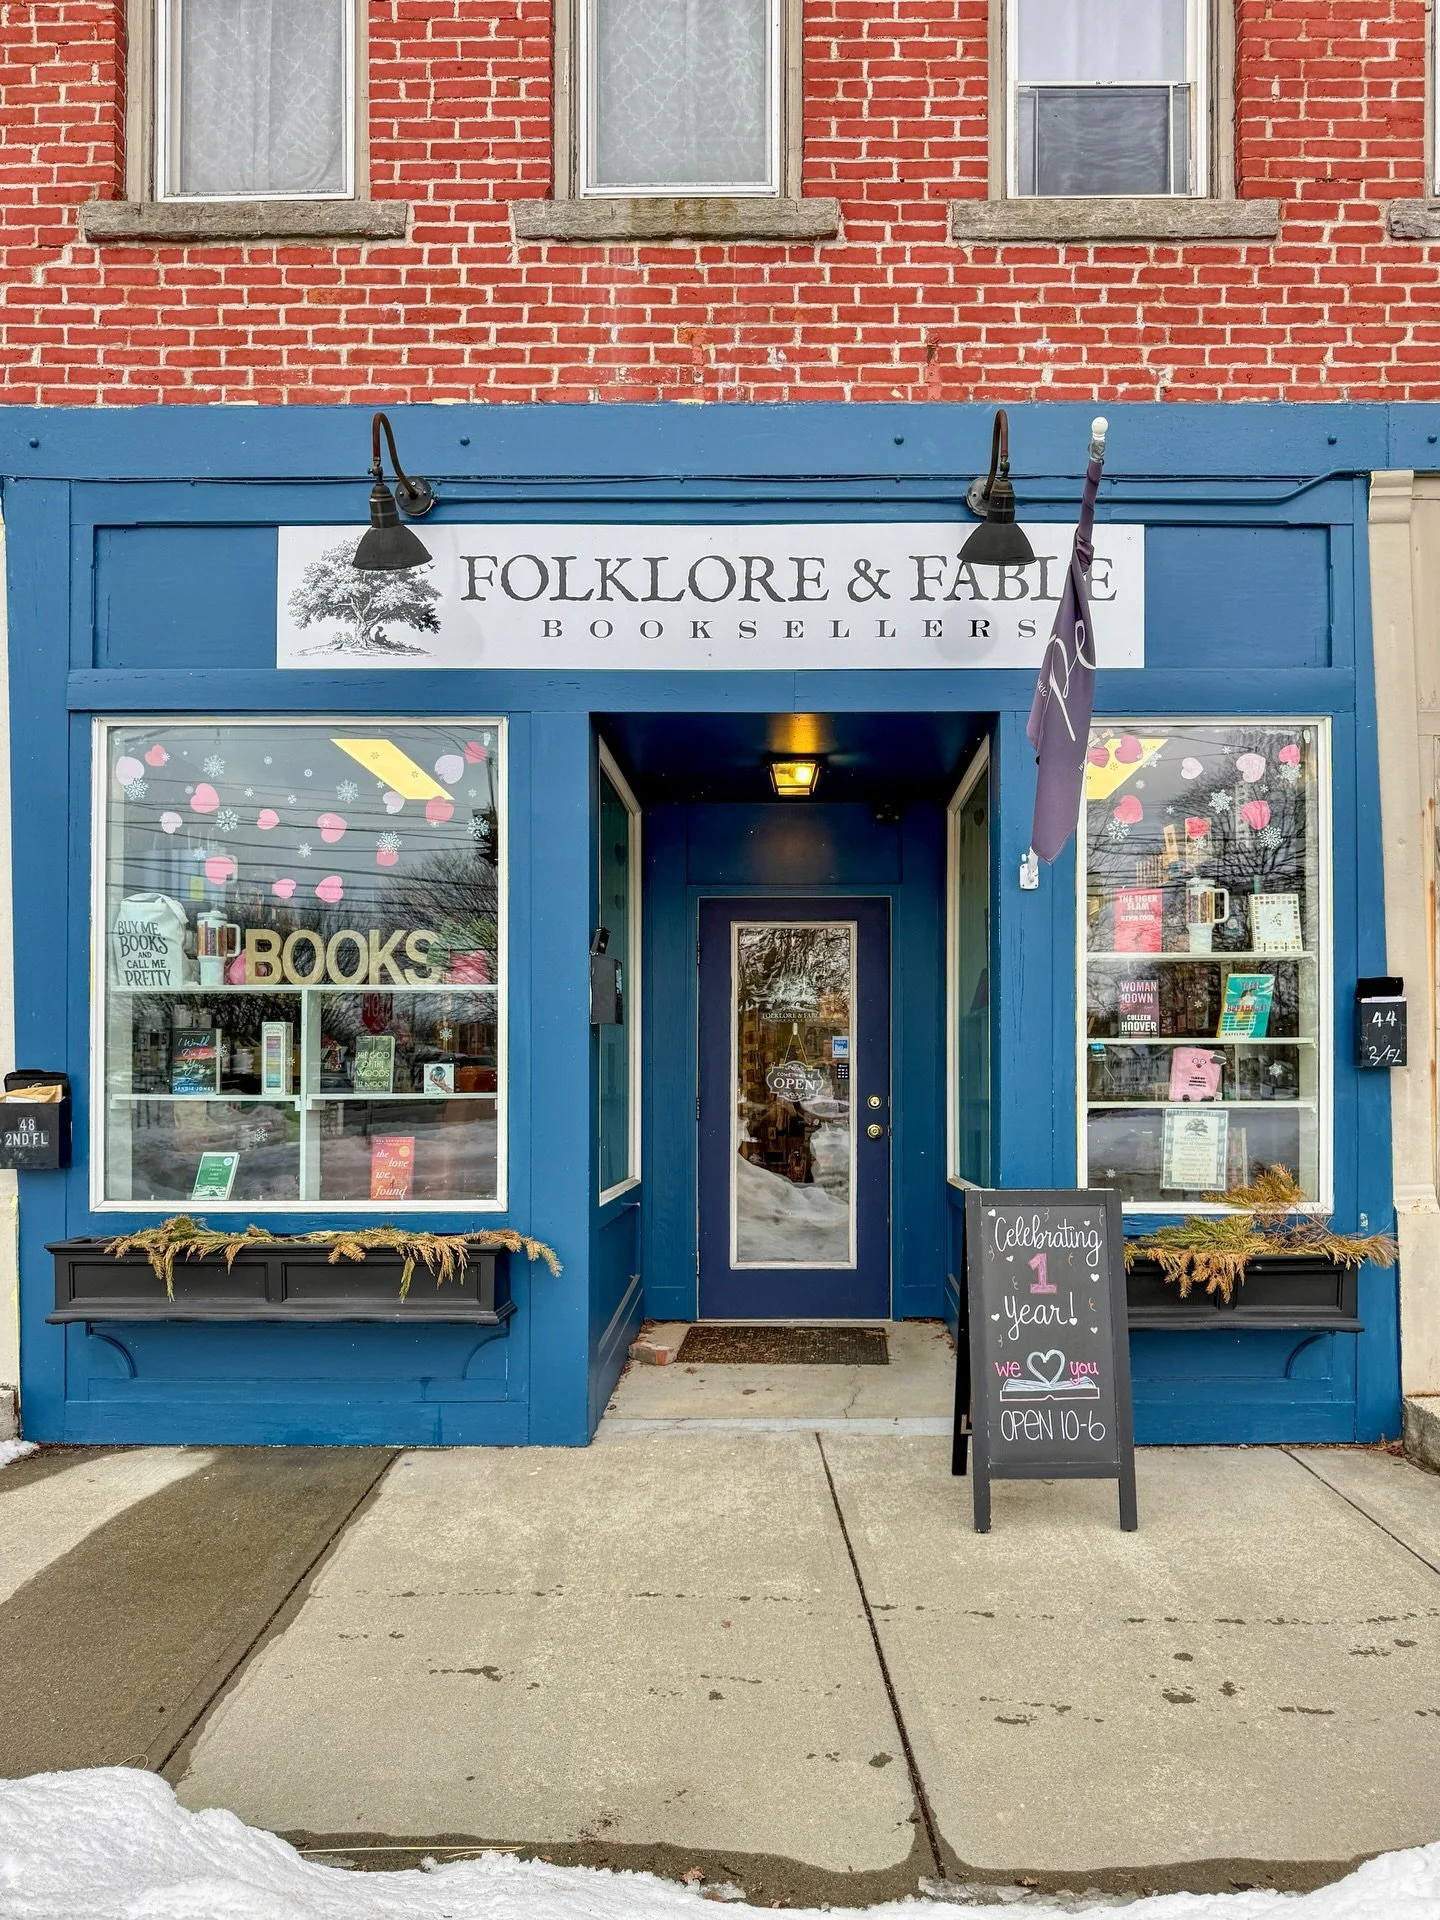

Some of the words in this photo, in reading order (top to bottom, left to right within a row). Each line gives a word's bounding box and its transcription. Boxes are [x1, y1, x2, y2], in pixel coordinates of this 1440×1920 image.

[459, 554, 829, 602] FOLKLORE
[847, 557, 891, 602] &
[908, 555, 1117, 602] FABLE
[541, 619, 1037, 639] BOOKSELLERS
[1119, 895, 1134, 903] THE
[1134, 895, 1158, 903] TIGER
[1127, 902, 1150, 911] SLAM
[118, 921, 138, 935] BUY
[140, 921, 161, 936] ME
[119, 934, 168, 957] BOOKS
[126, 959, 149, 968] CALL
[151, 959, 167, 968] ME
[246, 928, 442, 985] BOOKS
[124, 969, 171, 986] PRETTY
[1120, 981, 1157, 992] WOMAN
[1123, 992, 1153, 1003] DOWN
[1371, 1010, 1398, 1028] 44
[1121, 1021, 1157, 1032] HOOVER
[369, 1051, 390, 1059] GOD
[1368, 1044, 1402, 1066] 2/FL
[185, 1059, 206, 1076] You
[356, 1069, 390, 1077] WOODS
[773, 1077, 817, 1091] OPEN
[20, 1119, 35, 1131] 48
[5, 1133, 29, 1146] 2ND
[32, 1132, 48, 1145] FL
[376, 1150, 390, 1158] the
[389, 1157, 410, 1167] love
[375, 1171, 391, 1179] we
[373, 1184, 408, 1199] found
[995, 1214, 1102, 1267] Celebrating
[1028, 1252, 1057, 1294] 1
[994, 1361, 1022, 1378] we
[1069, 1360, 1100, 1385] you
[1060, 1409, 1106, 1441] 10-6
